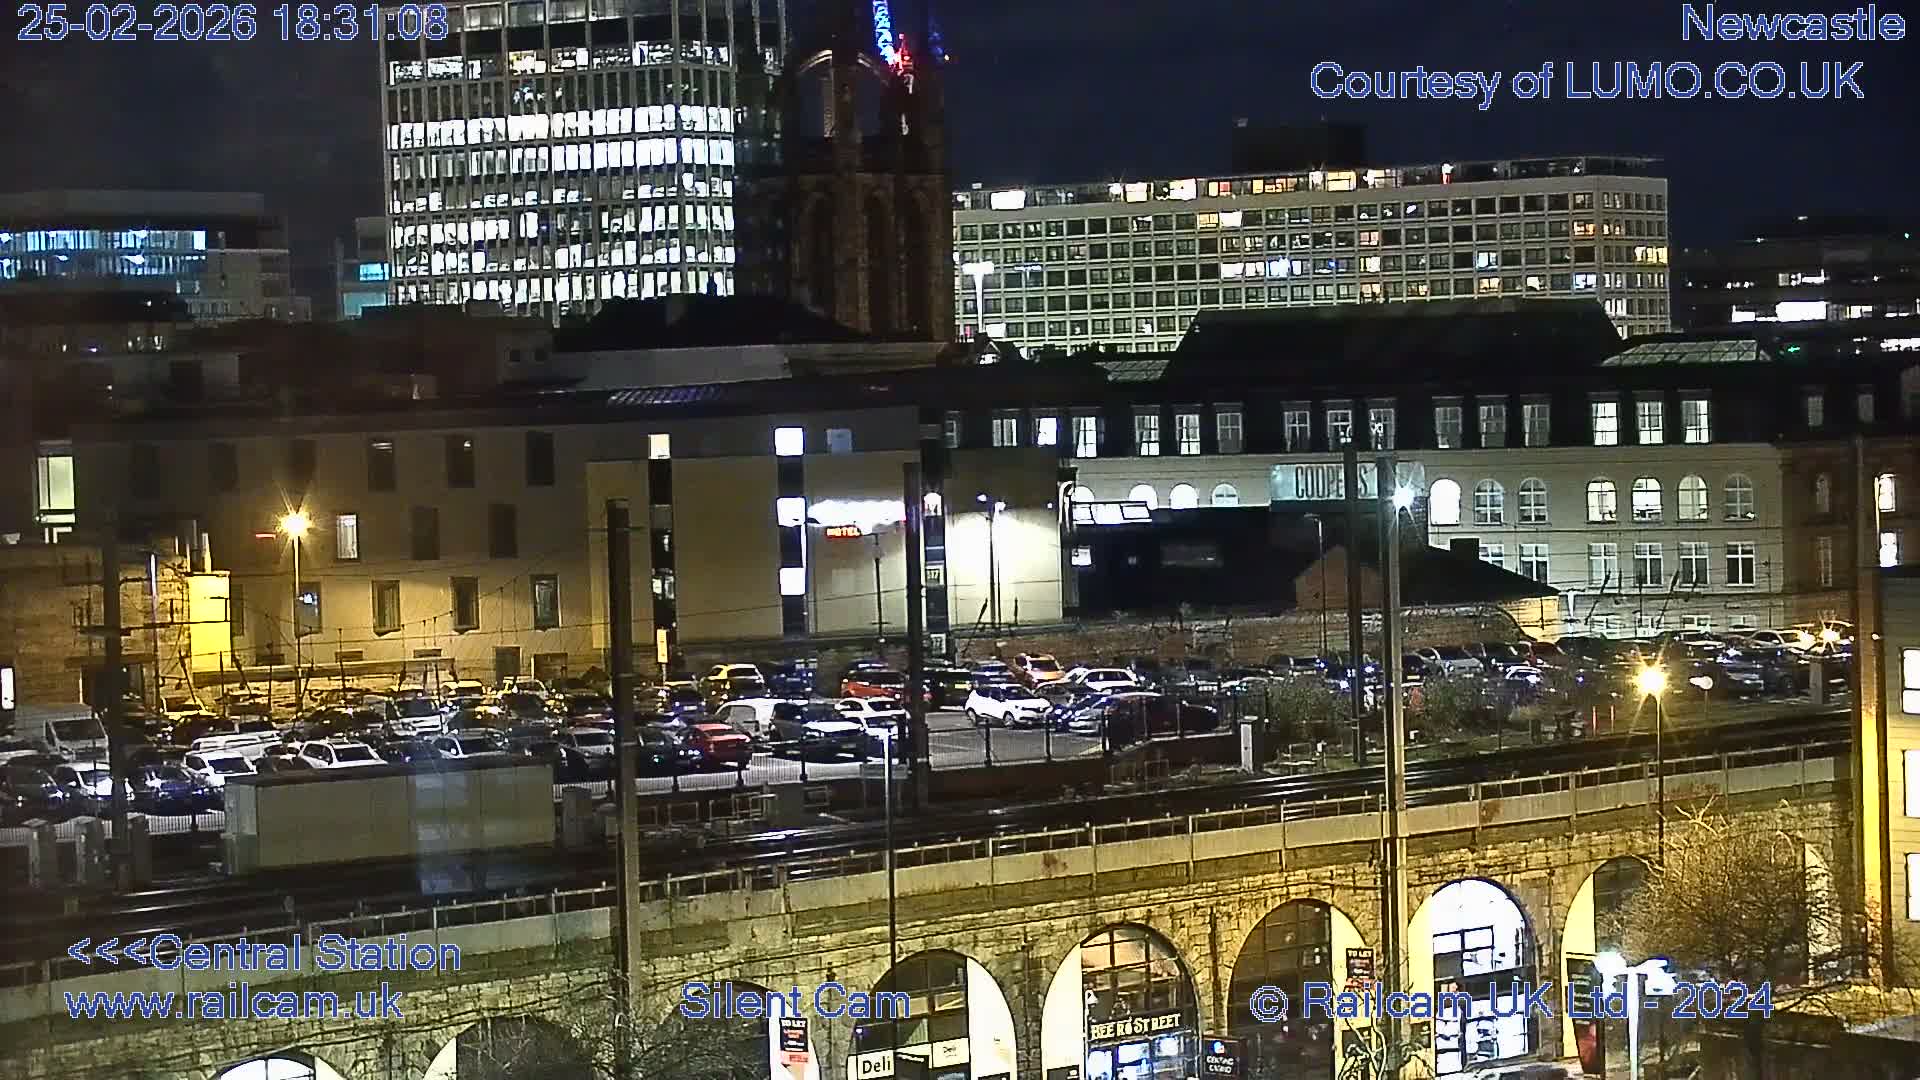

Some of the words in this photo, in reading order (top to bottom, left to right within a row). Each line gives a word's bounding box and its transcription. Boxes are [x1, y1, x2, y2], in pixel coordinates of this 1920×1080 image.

[1295, 465, 1368, 498] COOPES
[1134, 1013, 1181, 1034] STREET
[862, 1055, 892, 1075] Deli
